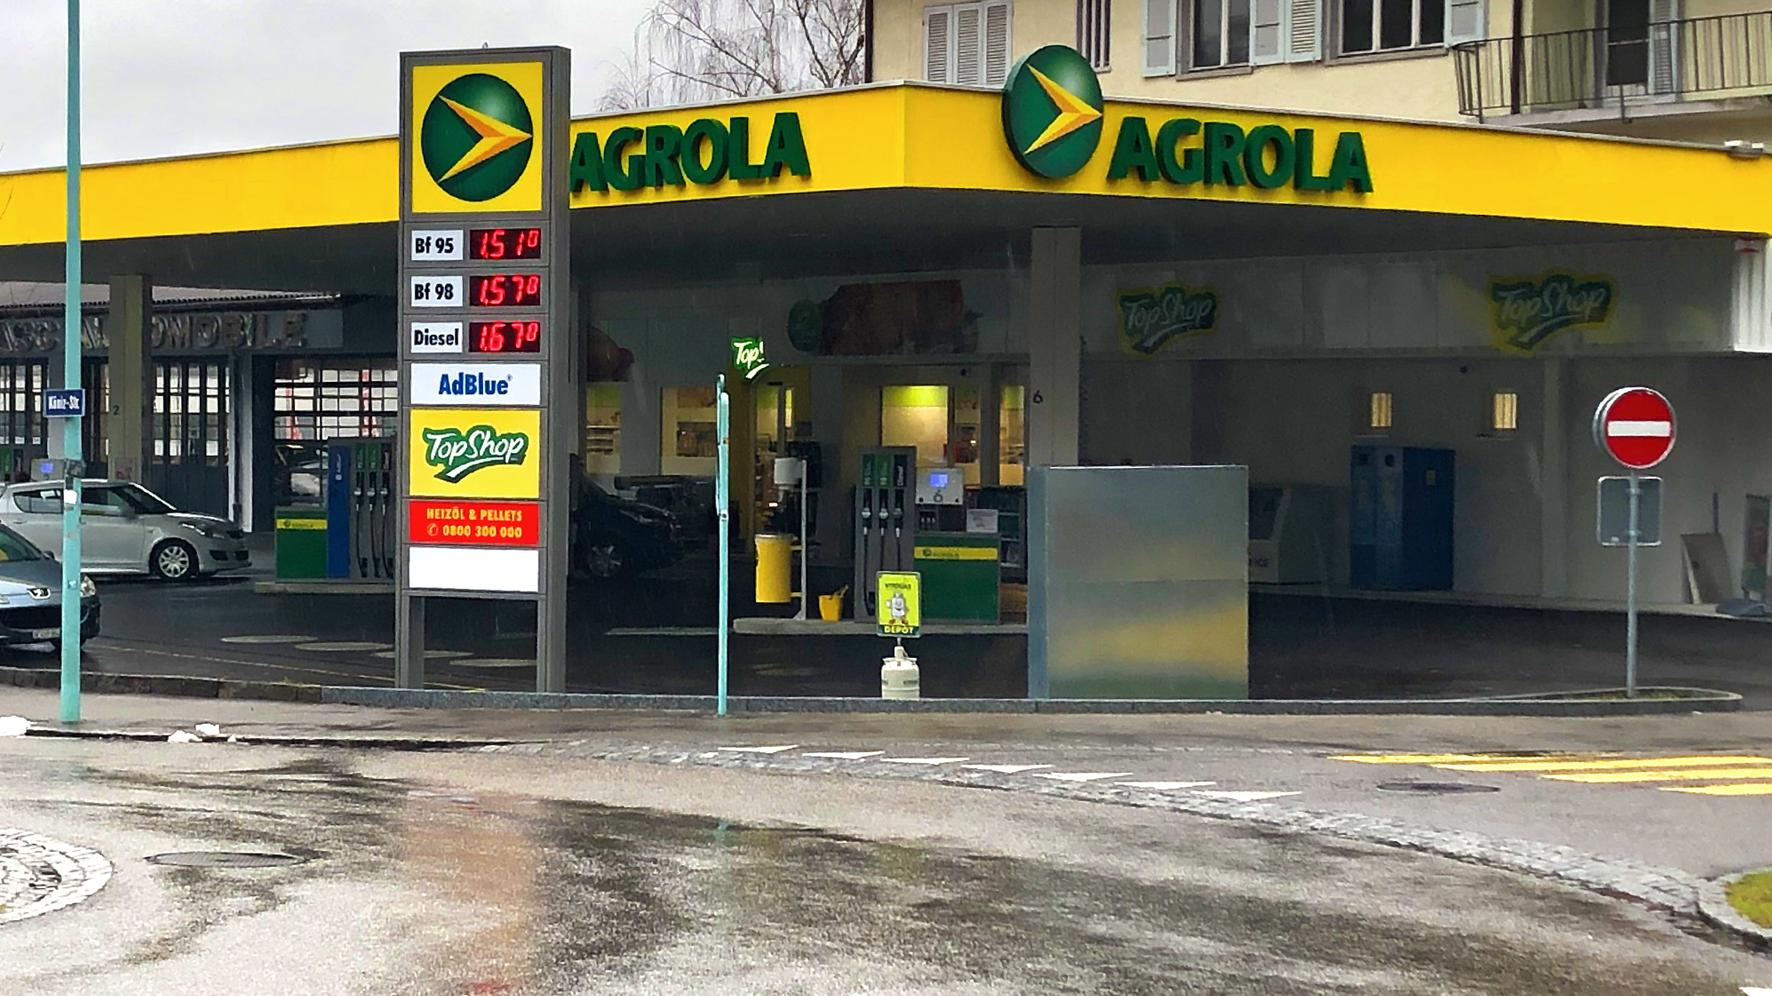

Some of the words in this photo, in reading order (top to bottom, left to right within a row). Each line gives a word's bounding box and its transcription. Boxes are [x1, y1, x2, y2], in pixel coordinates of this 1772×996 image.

[570, 112, 811, 192] AGROLA
[1107, 116, 1373, 193] AGROLA
[415, 237, 432, 254] Bf
[435, 238, 454, 254] 95
[414, 282, 431, 300] Bf
[435, 283, 454, 300] 98
[1126, 292, 1213, 334] TopShop
[1497, 281, 1607, 330] TopShop
[414, 327, 459, 346] Diesel
[733, 341, 766, 370] Top!
[1033, 389, 1043, 404] 6
[113, 404, 120, 416] 2
[426, 429, 525, 466] TopShop
[933, 489, 943, 503] 6
[426, 506, 465, 521] HEIZÖL
[469, 508, 476, 520] &
[480, 509, 523, 522] PELLETS
[442, 524, 471, 538] 0800
[475, 525, 497, 538] 300
[500, 526, 523, 539] 000
